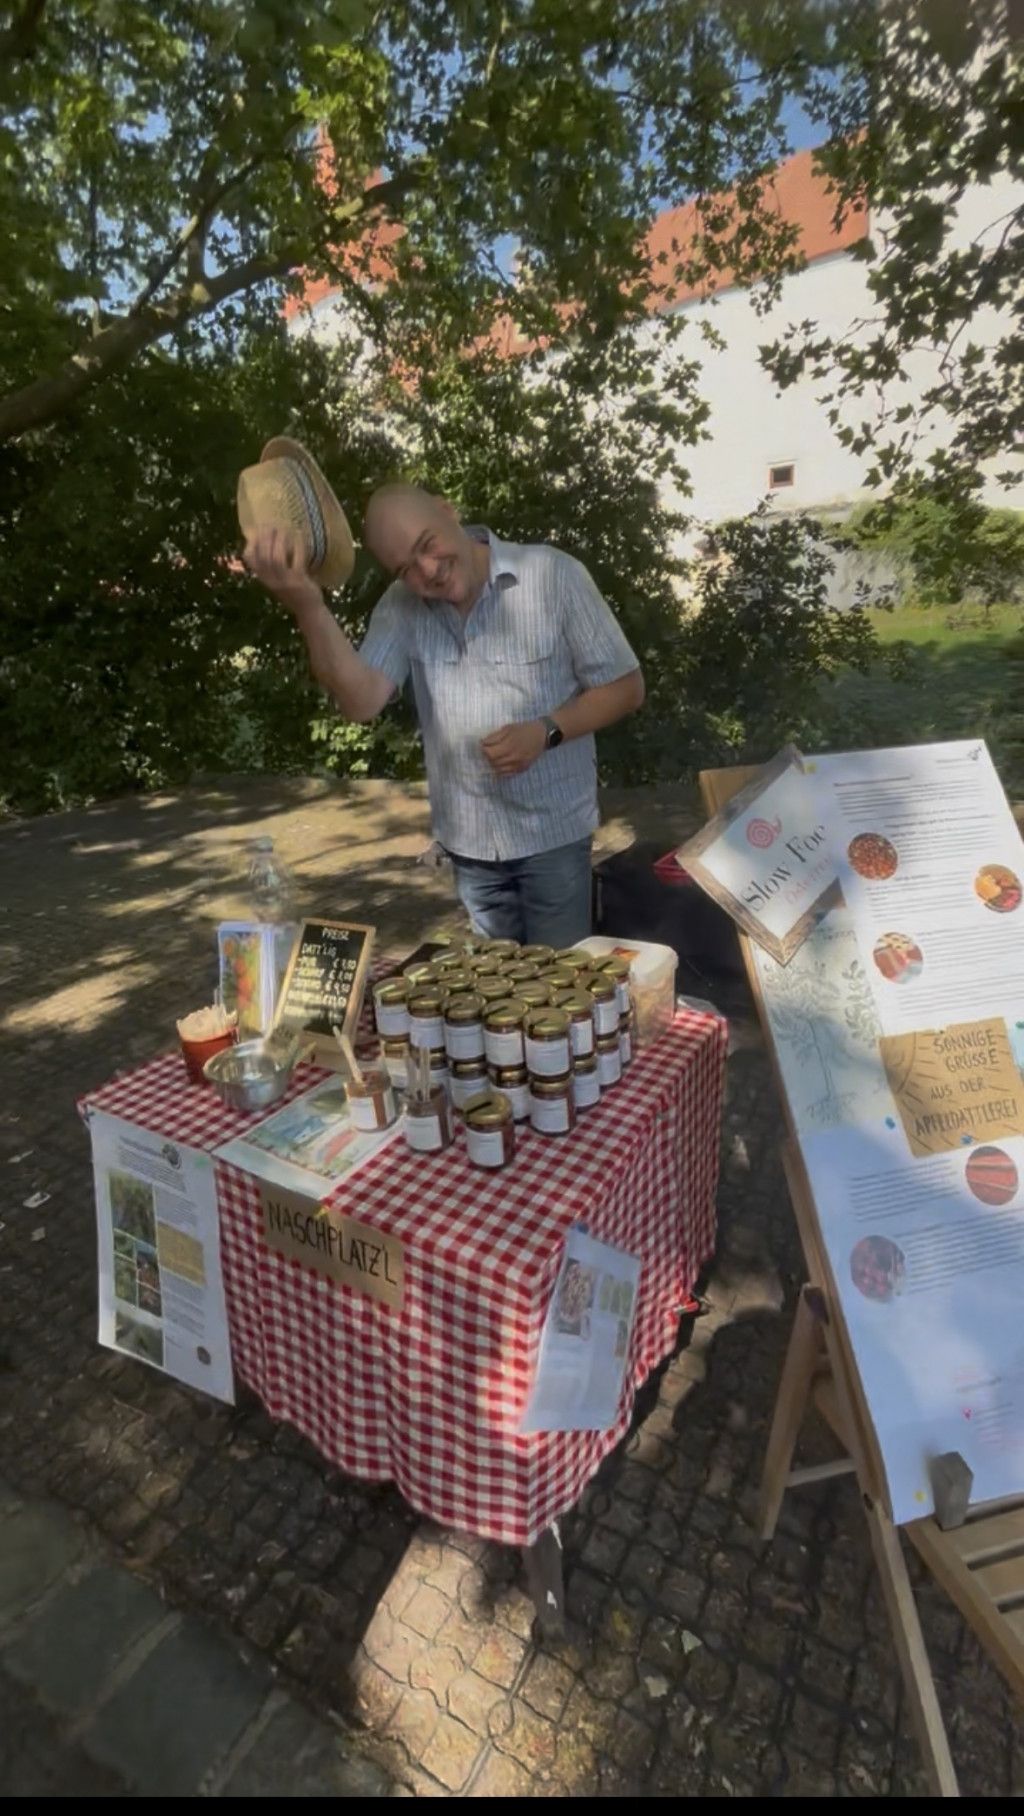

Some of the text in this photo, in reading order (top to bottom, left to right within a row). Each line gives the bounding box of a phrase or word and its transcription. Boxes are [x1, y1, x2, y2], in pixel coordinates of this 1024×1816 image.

[741, 861, 791, 911] Slow
[933, 1029, 997, 1054] SONNIGE
[930, 1077, 987, 1100] AUS DER
